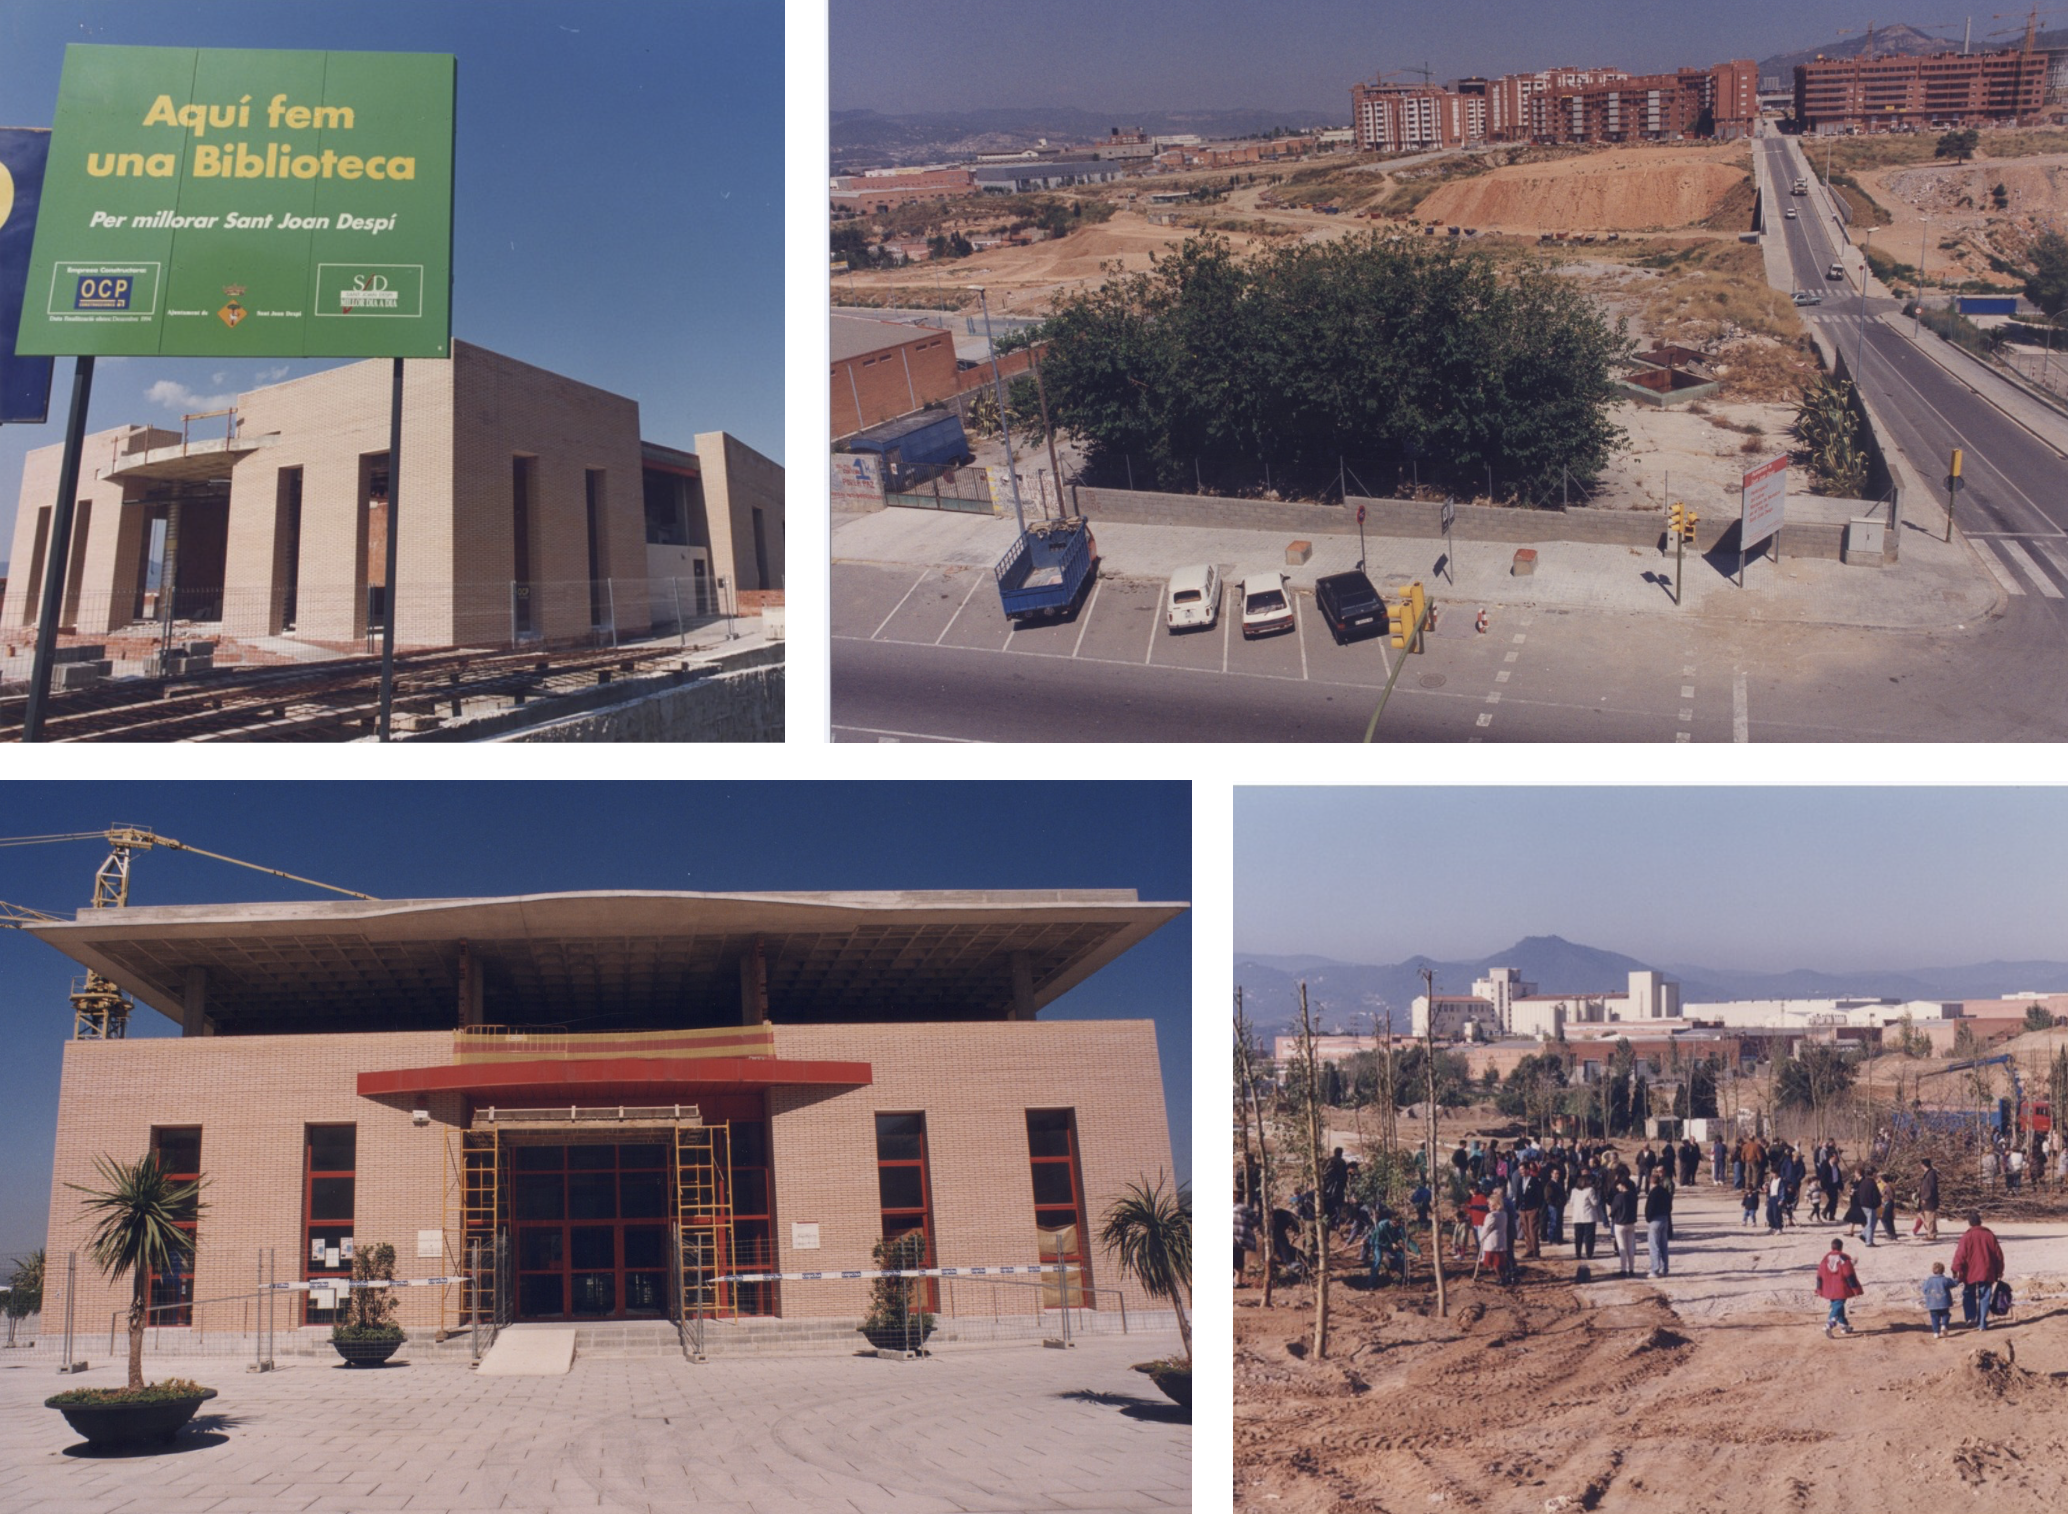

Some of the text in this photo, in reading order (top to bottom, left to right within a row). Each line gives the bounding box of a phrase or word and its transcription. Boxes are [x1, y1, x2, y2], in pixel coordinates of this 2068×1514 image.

[142, 94, 355, 137] Aquí fem
[86, 142, 416, 180] una Biblioteca
[89, 211, 396, 234] Per millorar Sant Joan Despí
[80, 279, 128, 298] OCP
